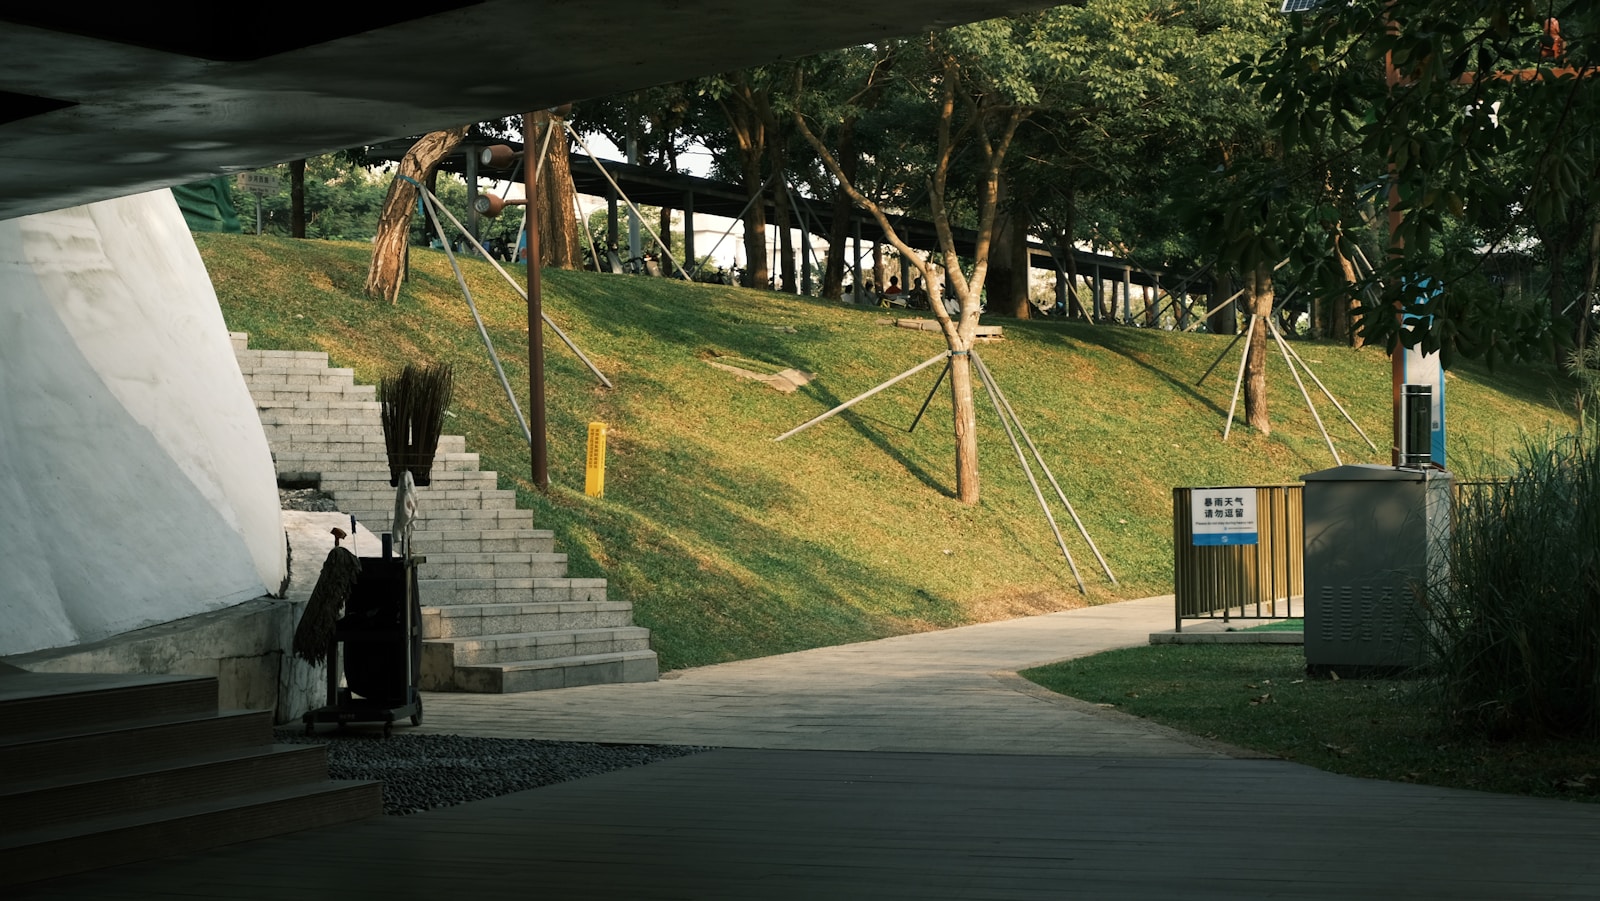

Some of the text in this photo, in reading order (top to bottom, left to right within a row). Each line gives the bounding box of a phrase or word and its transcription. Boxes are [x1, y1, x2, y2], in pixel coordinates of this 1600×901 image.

[1204, 497, 1244, 506] 暴雨天气
[1204, 508, 1244, 518] 请勿逗留
